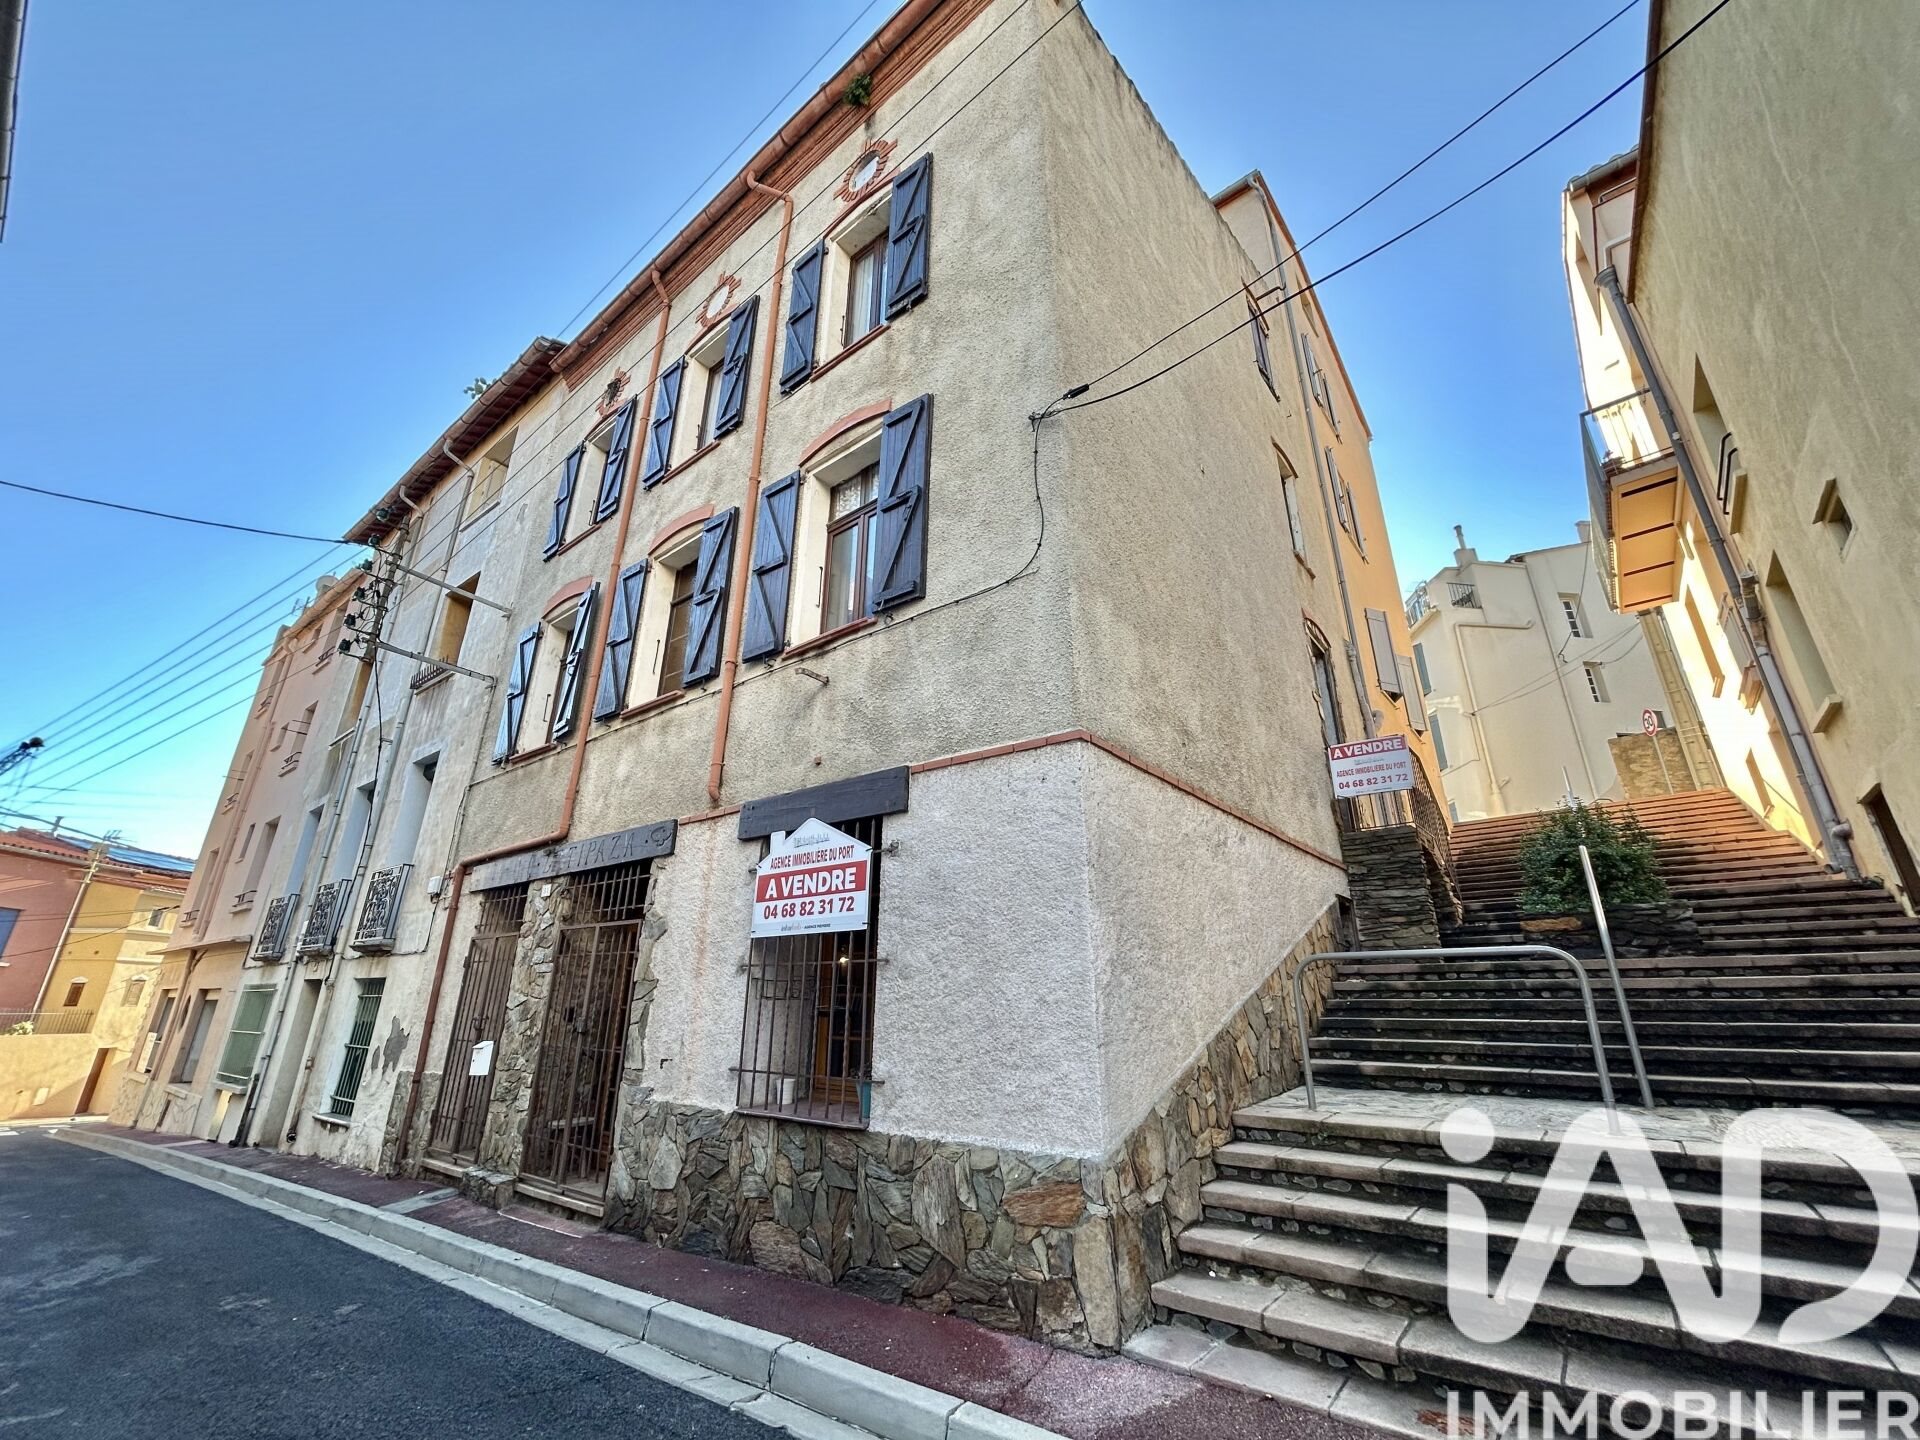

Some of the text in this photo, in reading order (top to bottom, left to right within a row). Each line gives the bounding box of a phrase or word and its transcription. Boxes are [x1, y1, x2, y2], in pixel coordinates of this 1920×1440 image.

[1644, 716, 1653, 729] 30
[1334, 738, 1402, 759] A VENDRE
[1336, 768, 1354, 778] AGENCE
[1338, 782, 1350, 790] 04
[1352, 779, 1364, 787] 68
[1367, 777, 1378, 786] 82
[1381, 775, 1392, 783] 31
[770, 855, 791, 870] AGENCE
[829, 848, 838, 861] DU
[838, 845, 854, 860] PORT
[765, 867, 856, 899] A VENDRE
[764, 896, 854, 919] 04 68 82 31 72
